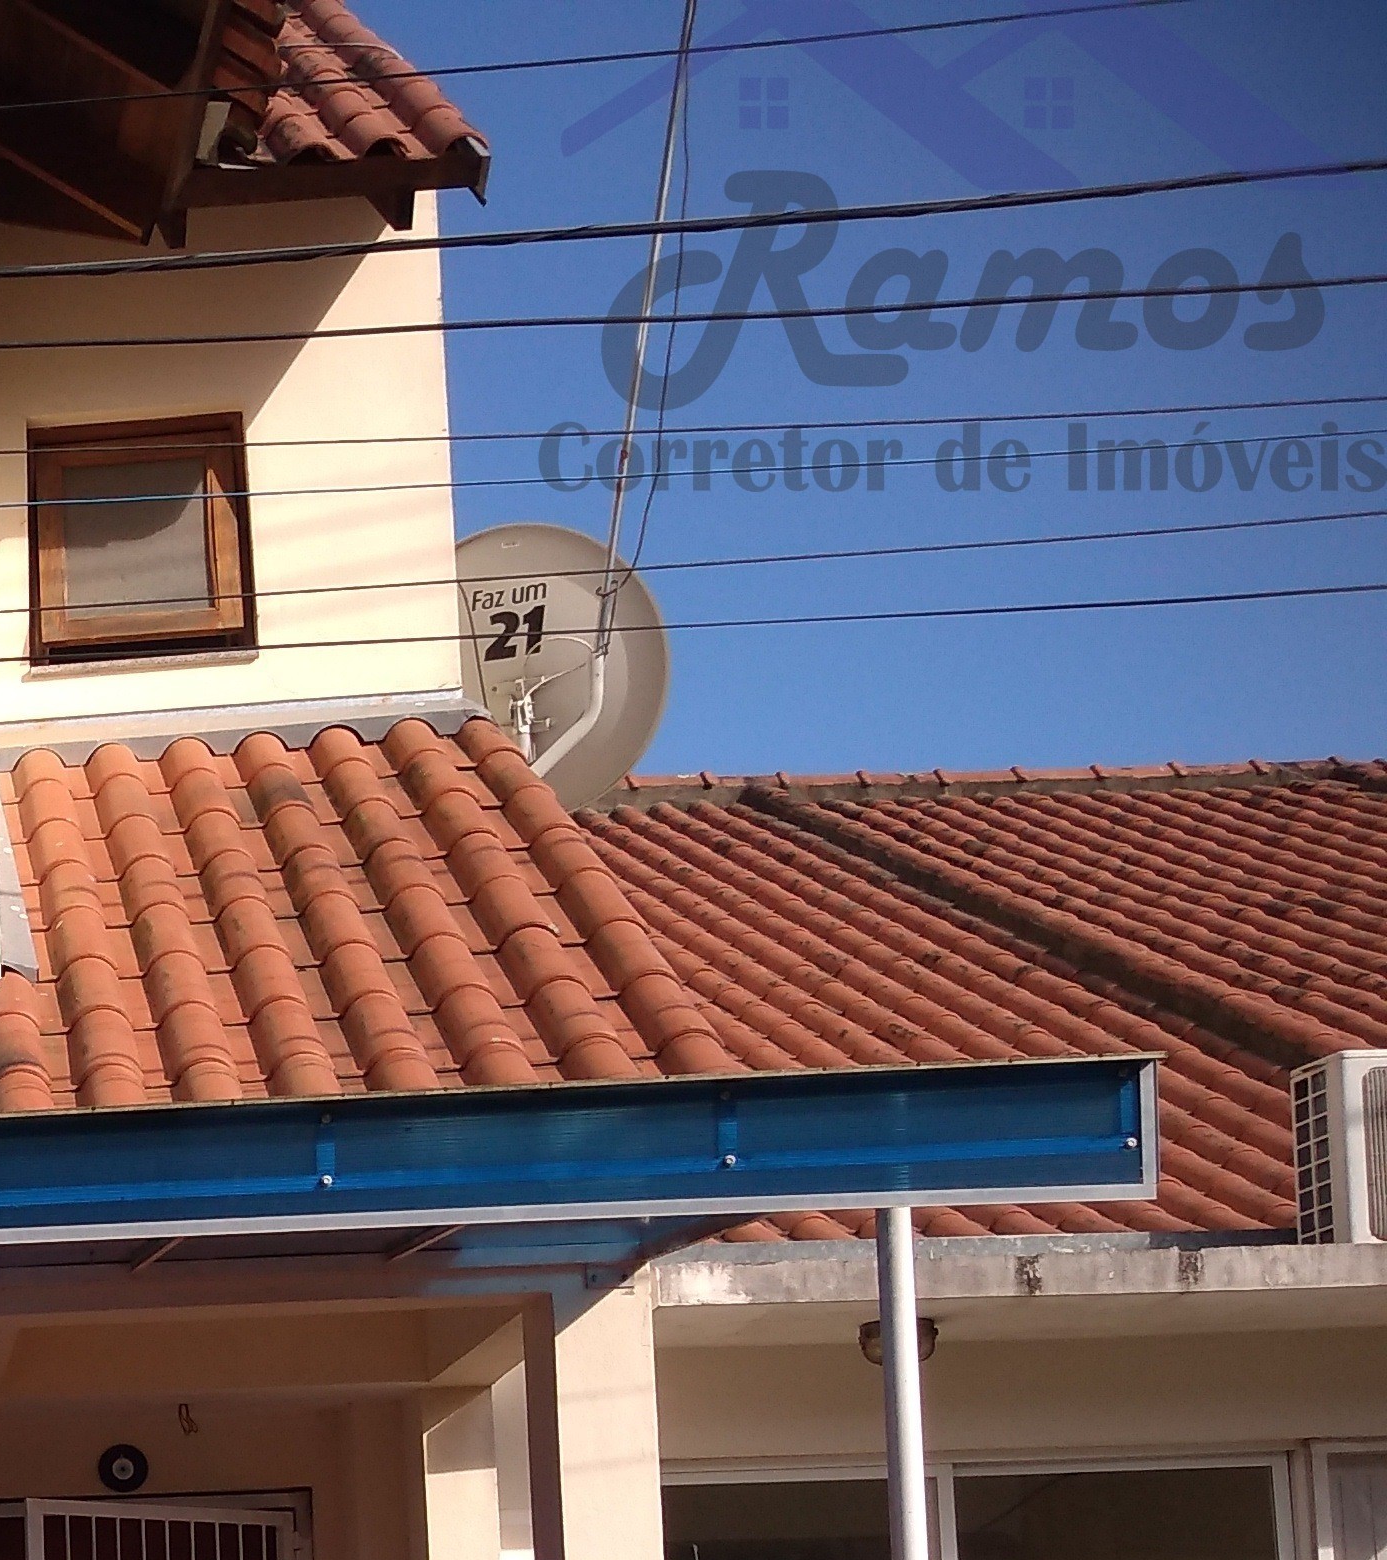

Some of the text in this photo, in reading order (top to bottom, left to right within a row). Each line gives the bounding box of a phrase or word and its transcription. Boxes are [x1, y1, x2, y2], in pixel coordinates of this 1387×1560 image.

[471, 582, 547, 612] Faz um
[484, 604, 546, 662] 21
